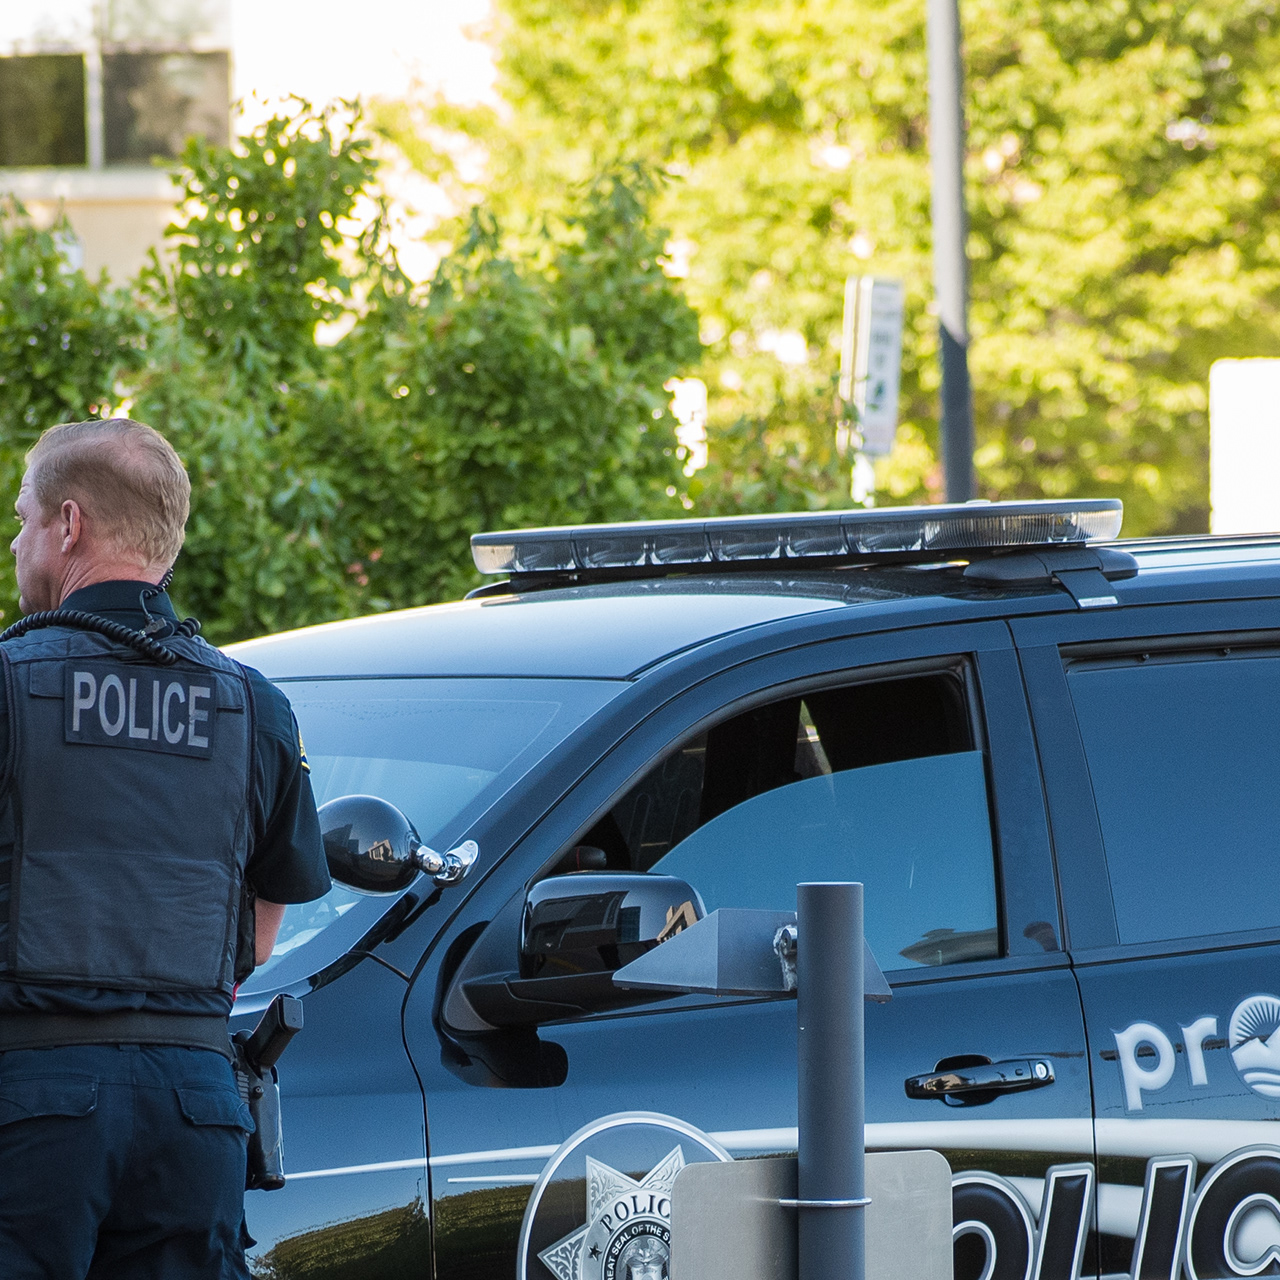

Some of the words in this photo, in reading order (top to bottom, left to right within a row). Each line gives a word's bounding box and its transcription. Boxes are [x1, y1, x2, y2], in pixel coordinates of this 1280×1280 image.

[72, 671, 211, 748] POLICE
[599, 1194, 671, 1236] POLIC
[611, 1232, 632, 1256] SEAL
[631, 1224, 644, 1236] OF
[645, 1224, 663, 1237] THE
